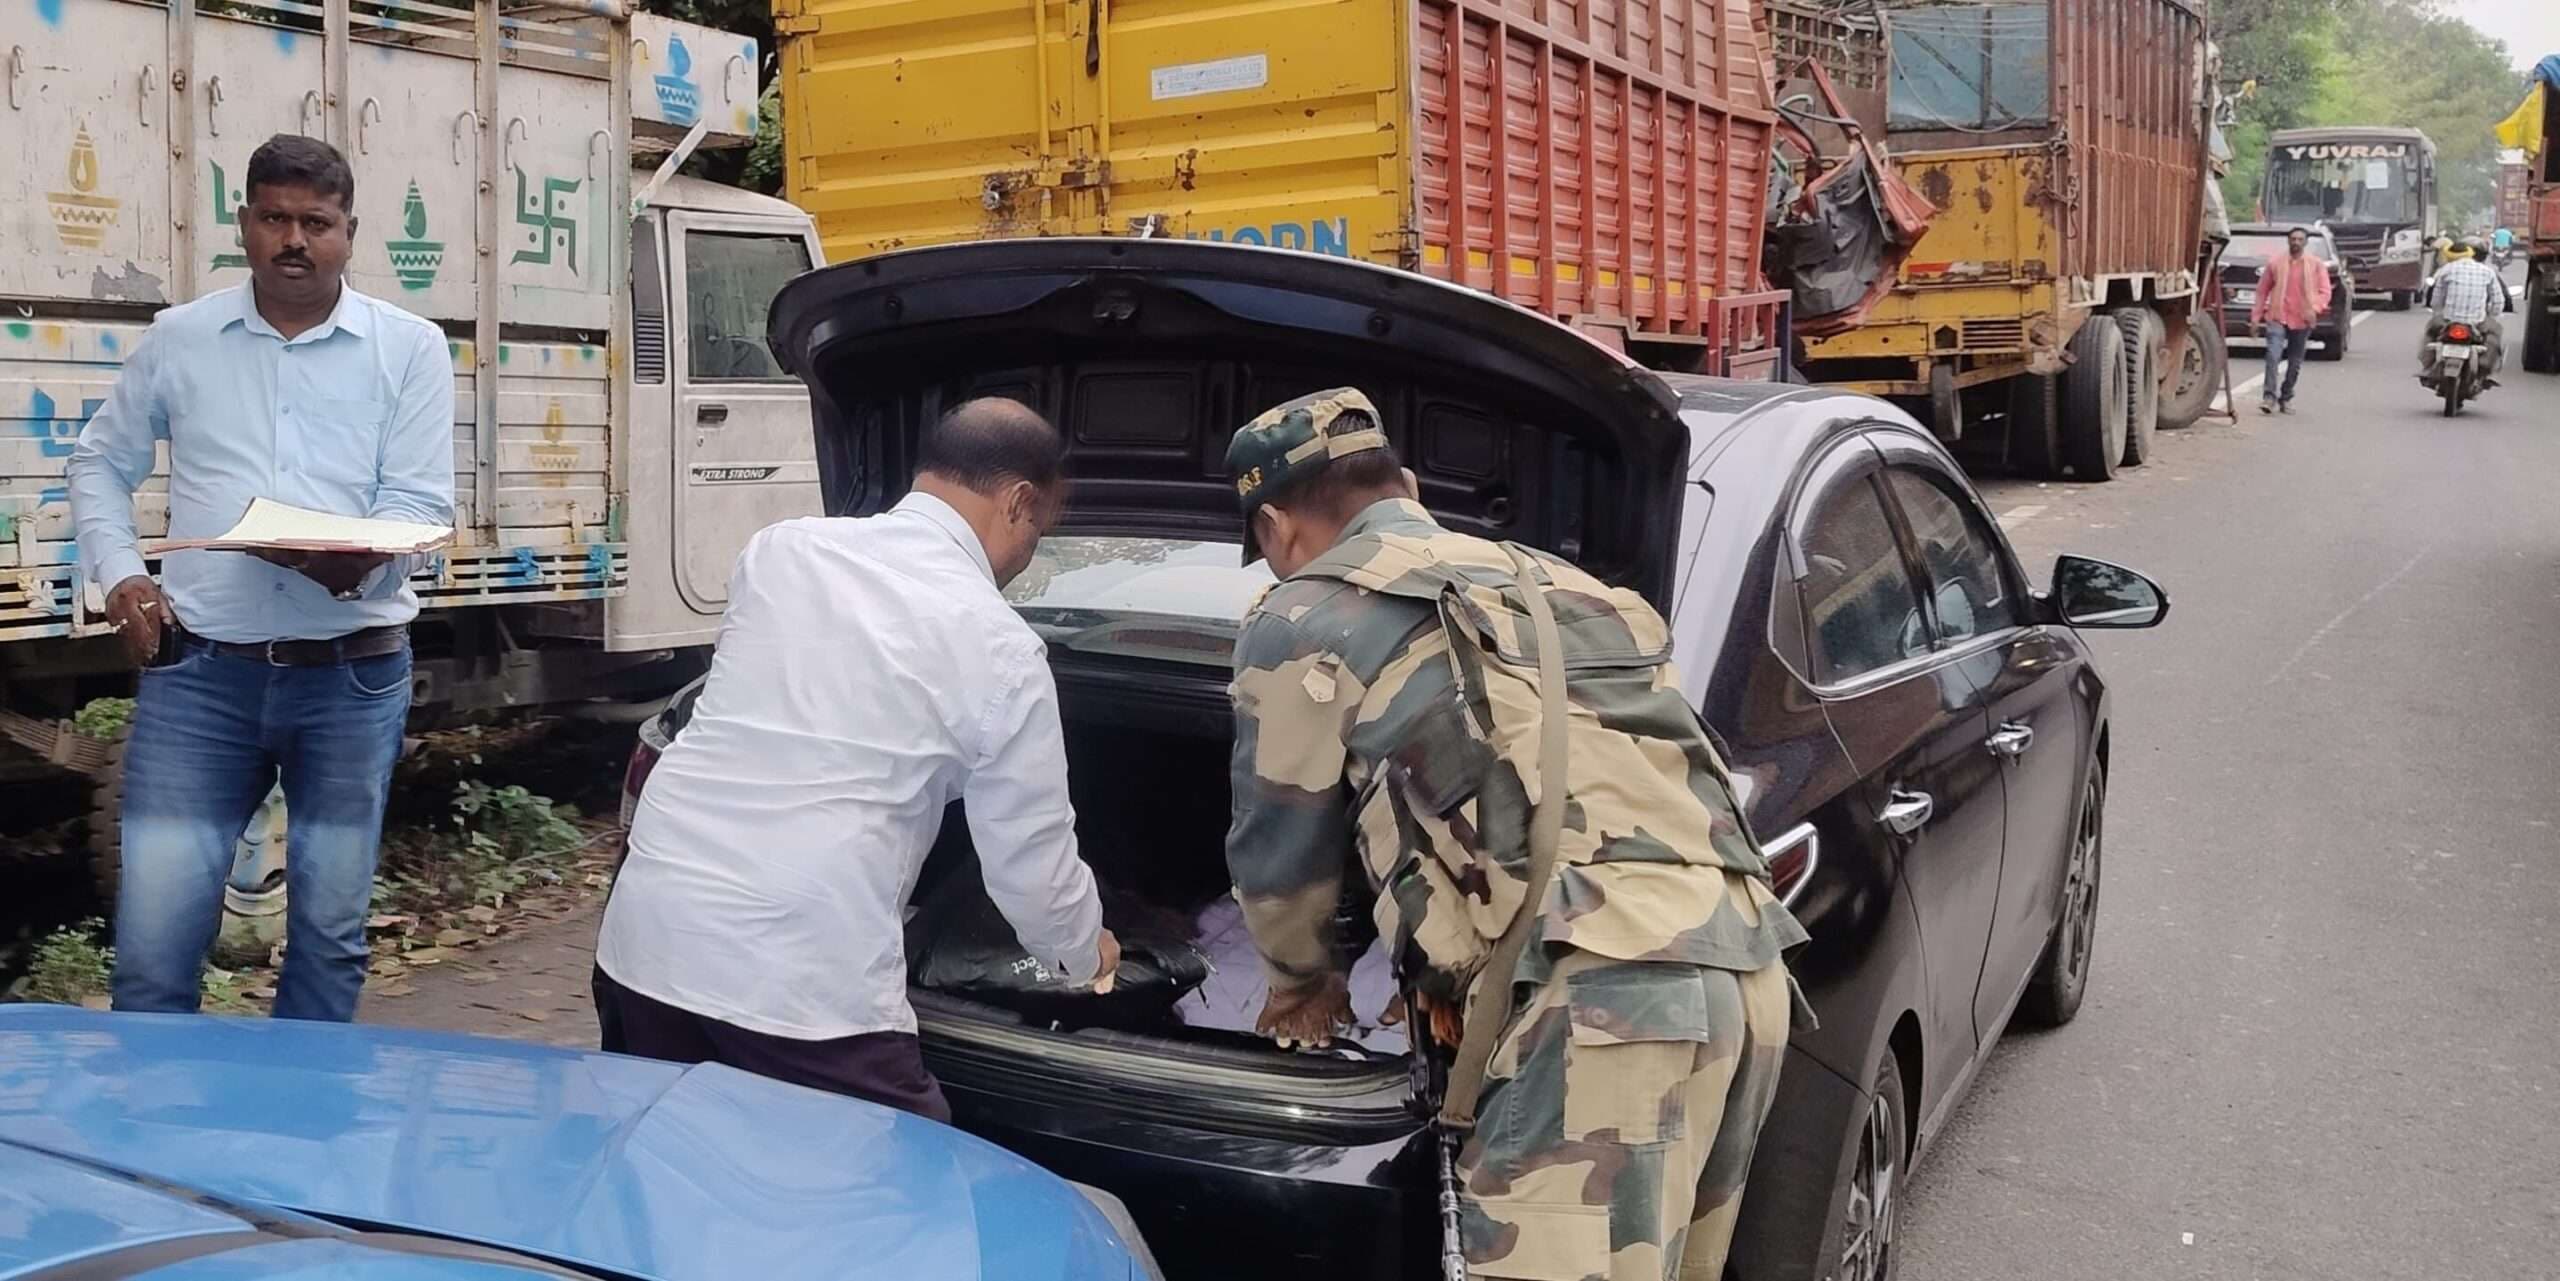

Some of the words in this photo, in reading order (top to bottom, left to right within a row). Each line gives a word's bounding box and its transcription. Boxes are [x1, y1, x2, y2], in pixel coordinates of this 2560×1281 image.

[2286, 144, 2406, 160] YUVRAJ
[1186, 217, 1348, 257] ORN
[728, 468, 766, 480] STRONG
